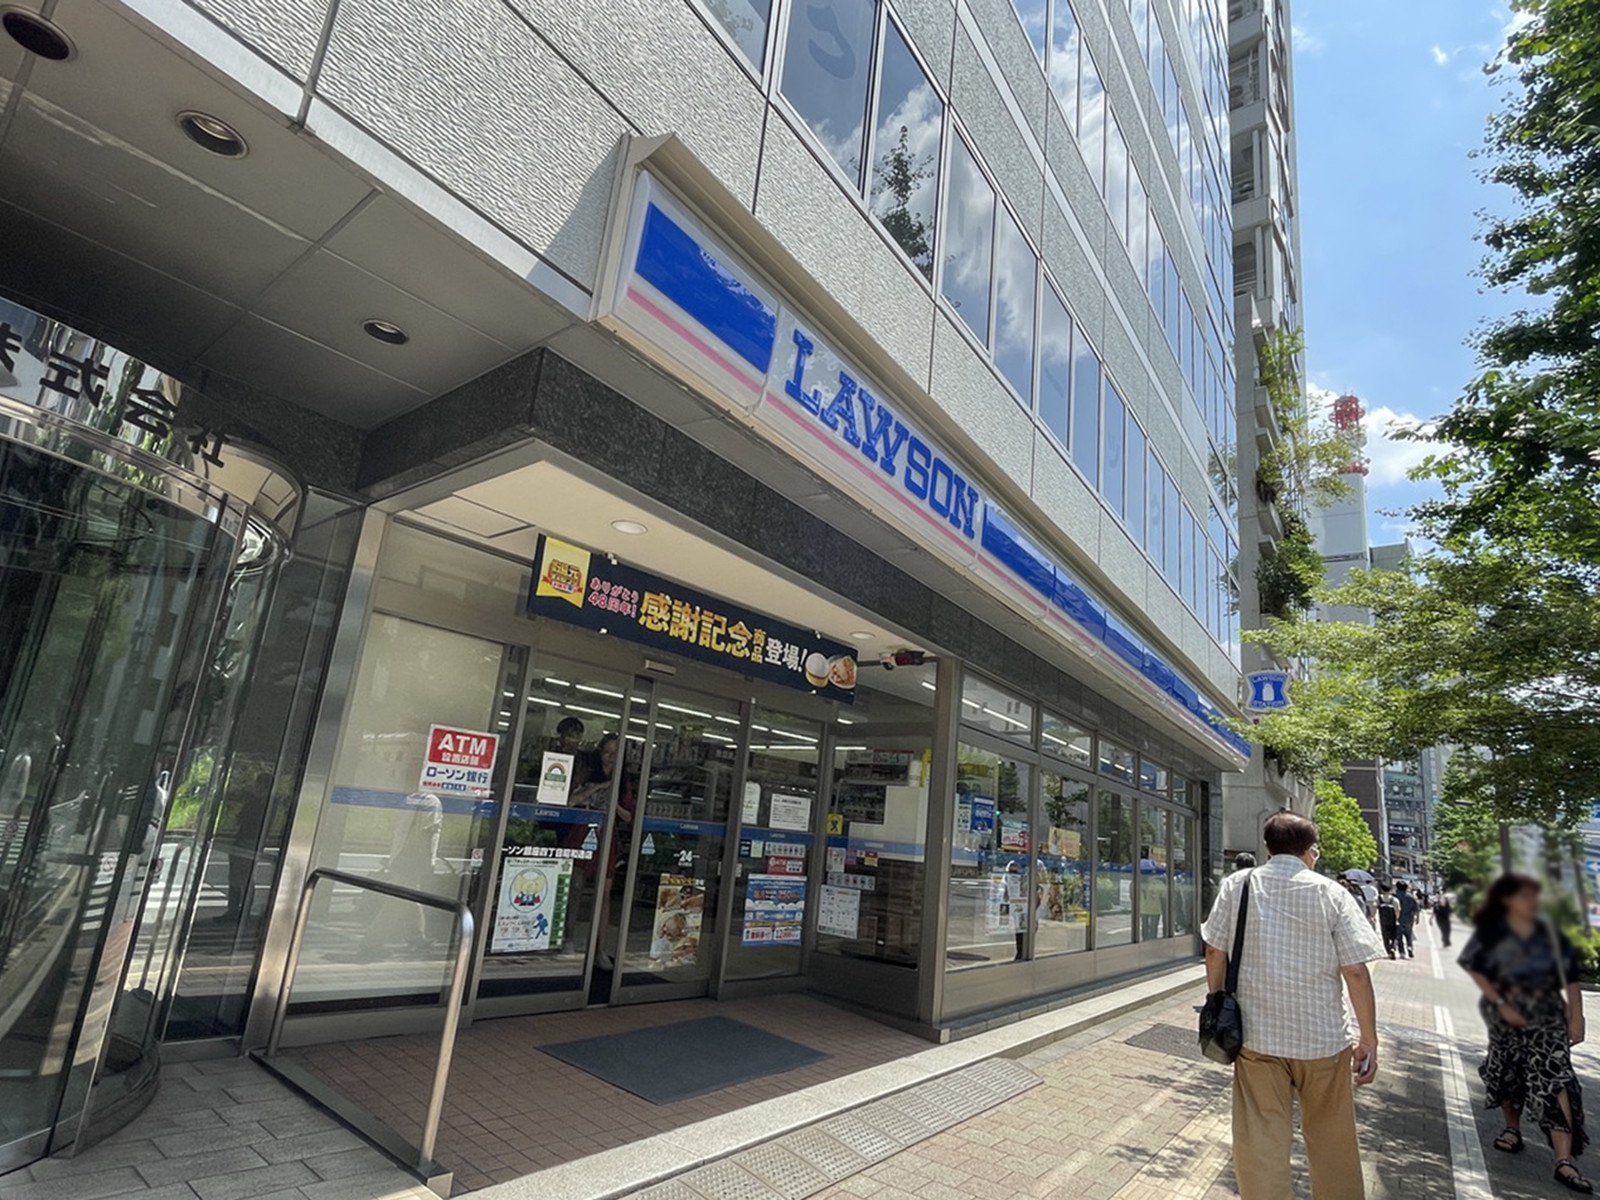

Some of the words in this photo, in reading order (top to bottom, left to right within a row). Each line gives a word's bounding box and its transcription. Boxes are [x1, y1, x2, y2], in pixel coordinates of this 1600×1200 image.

[784, 329, 979, 539] LAWSON
[590, 577, 639, 604] ありがとう
[588, 591, 638, 618] 48周年!
[638, 590, 754, 659] 感謝記念
[764, 637, 809, 673] 登場!
[437, 733, 488, 756] ATM
[426, 766, 489, 784] ローソン銀行
